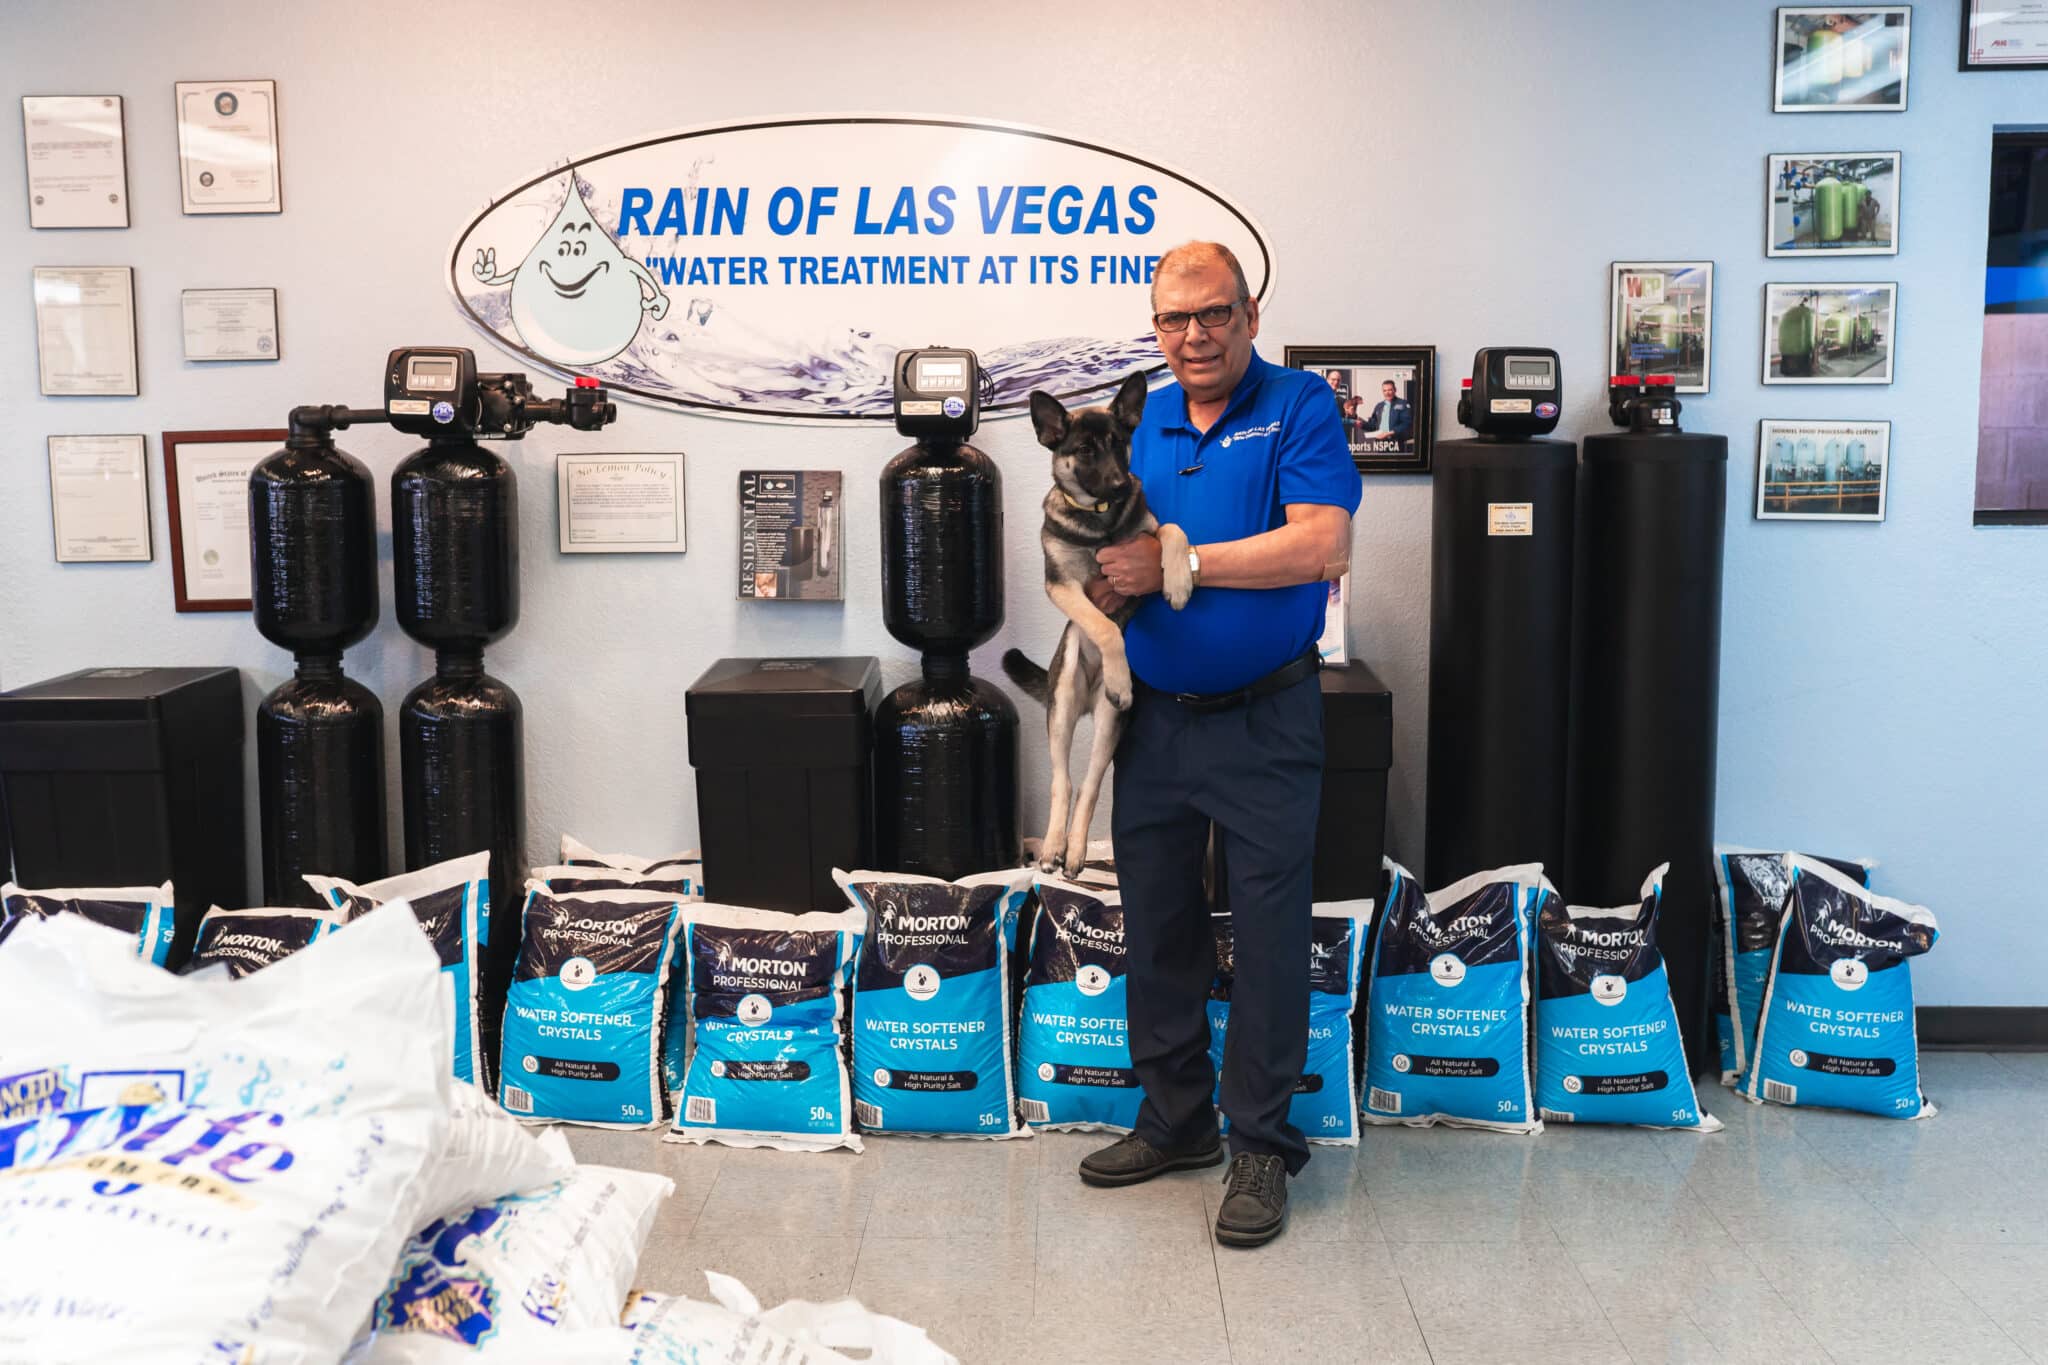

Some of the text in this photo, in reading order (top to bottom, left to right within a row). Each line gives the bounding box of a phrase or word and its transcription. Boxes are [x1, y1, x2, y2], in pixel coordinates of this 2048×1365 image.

[617, 185, 1158, 236] RAIN OF LAS VEGAS
[646, 255, 1160, 285] "WATER TREATMENT AT ITS FINE
[1373, 441, 1399, 452] NSPCA
[743, 474, 756, 595] RESIDENTIAL
[899, 916, 971, 931] MORTON
[1427, 913, 1492, 939] MRTON
[543, 929, 633, 947] PROFESSIONAL
[1077, 920, 1125, 943] MORT
[1828, 919, 1902, 950] MORTON
[877, 933, 968, 946] PROFESSIONAL
[1056, 930, 1127, 955] PROFESSIO
[732, 957, 806, 976] MORTON
[713, 975, 801, 990] PROFESSIONAL
[516, 1007, 632, 1026] WATER SOFTENER
[1385, 1004, 1432, 1019] WATER
[1786, 1000, 1904, 1024] WATER SOFTENER
[865, 1019, 985, 1034] WATER SOFTENER
[1032, 1013, 1128, 1031] WATER SOFTE
[1552, 1020, 1667, 1039] WATER SOFTENER
[538, 1025, 602, 1040] CRYSTALS
[727, 1030, 793, 1042] CRYSTALS
[1412, 1023, 1480, 1037] CRYSTALS
[1810, 1022, 1880, 1038] CRYSTALS
[890, 1037, 958, 1050] CRYSTALS
[1056, 1031, 1124, 1046] CRYSTALS
[1579, 1040, 1648, 1055] CRYSTALS
[621, 1105, 635, 1116] 50
[1497, 1100, 1511, 1112] 50
[1895, 1098, 1909, 1109] 50
[810, 1106, 824, 1120] 50
[979, 1113, 993, 1126] 50
[1672, 1108, 1686, 1121] 50
[1322, 1115, 1336, 1128] 50
